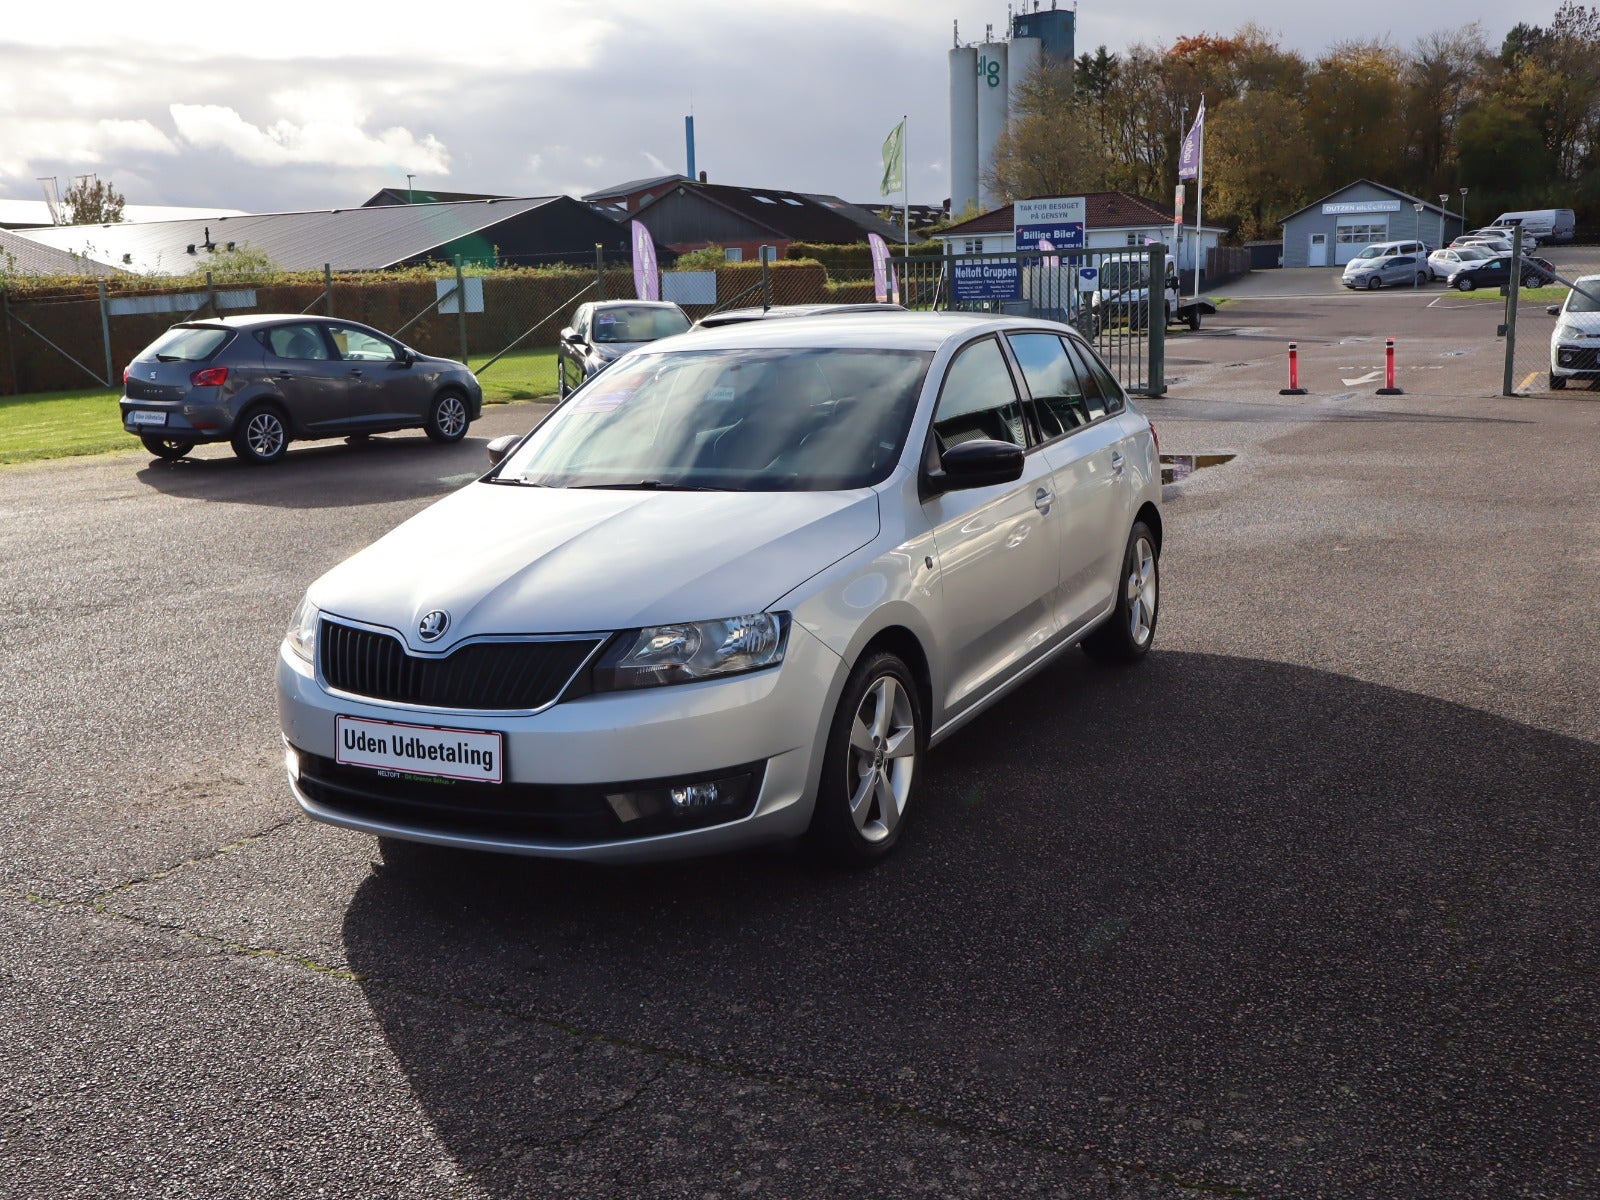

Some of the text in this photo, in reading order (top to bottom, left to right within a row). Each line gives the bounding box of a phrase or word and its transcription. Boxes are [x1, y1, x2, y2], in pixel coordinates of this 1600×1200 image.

[1049, 202, 1079, 210] BESØGET
[1325, 204, 1355, 212] OUTZEN
[1030, 212, 1039, 220] PÅ
[1023, 229, 1076, 240] Billige Biler
[955, 266, 1018, 279] Neltoft Gruppen
[344, 728, 493, 771] Uden Udbetaling
[377, 770, 401, 779] NELTOFT
